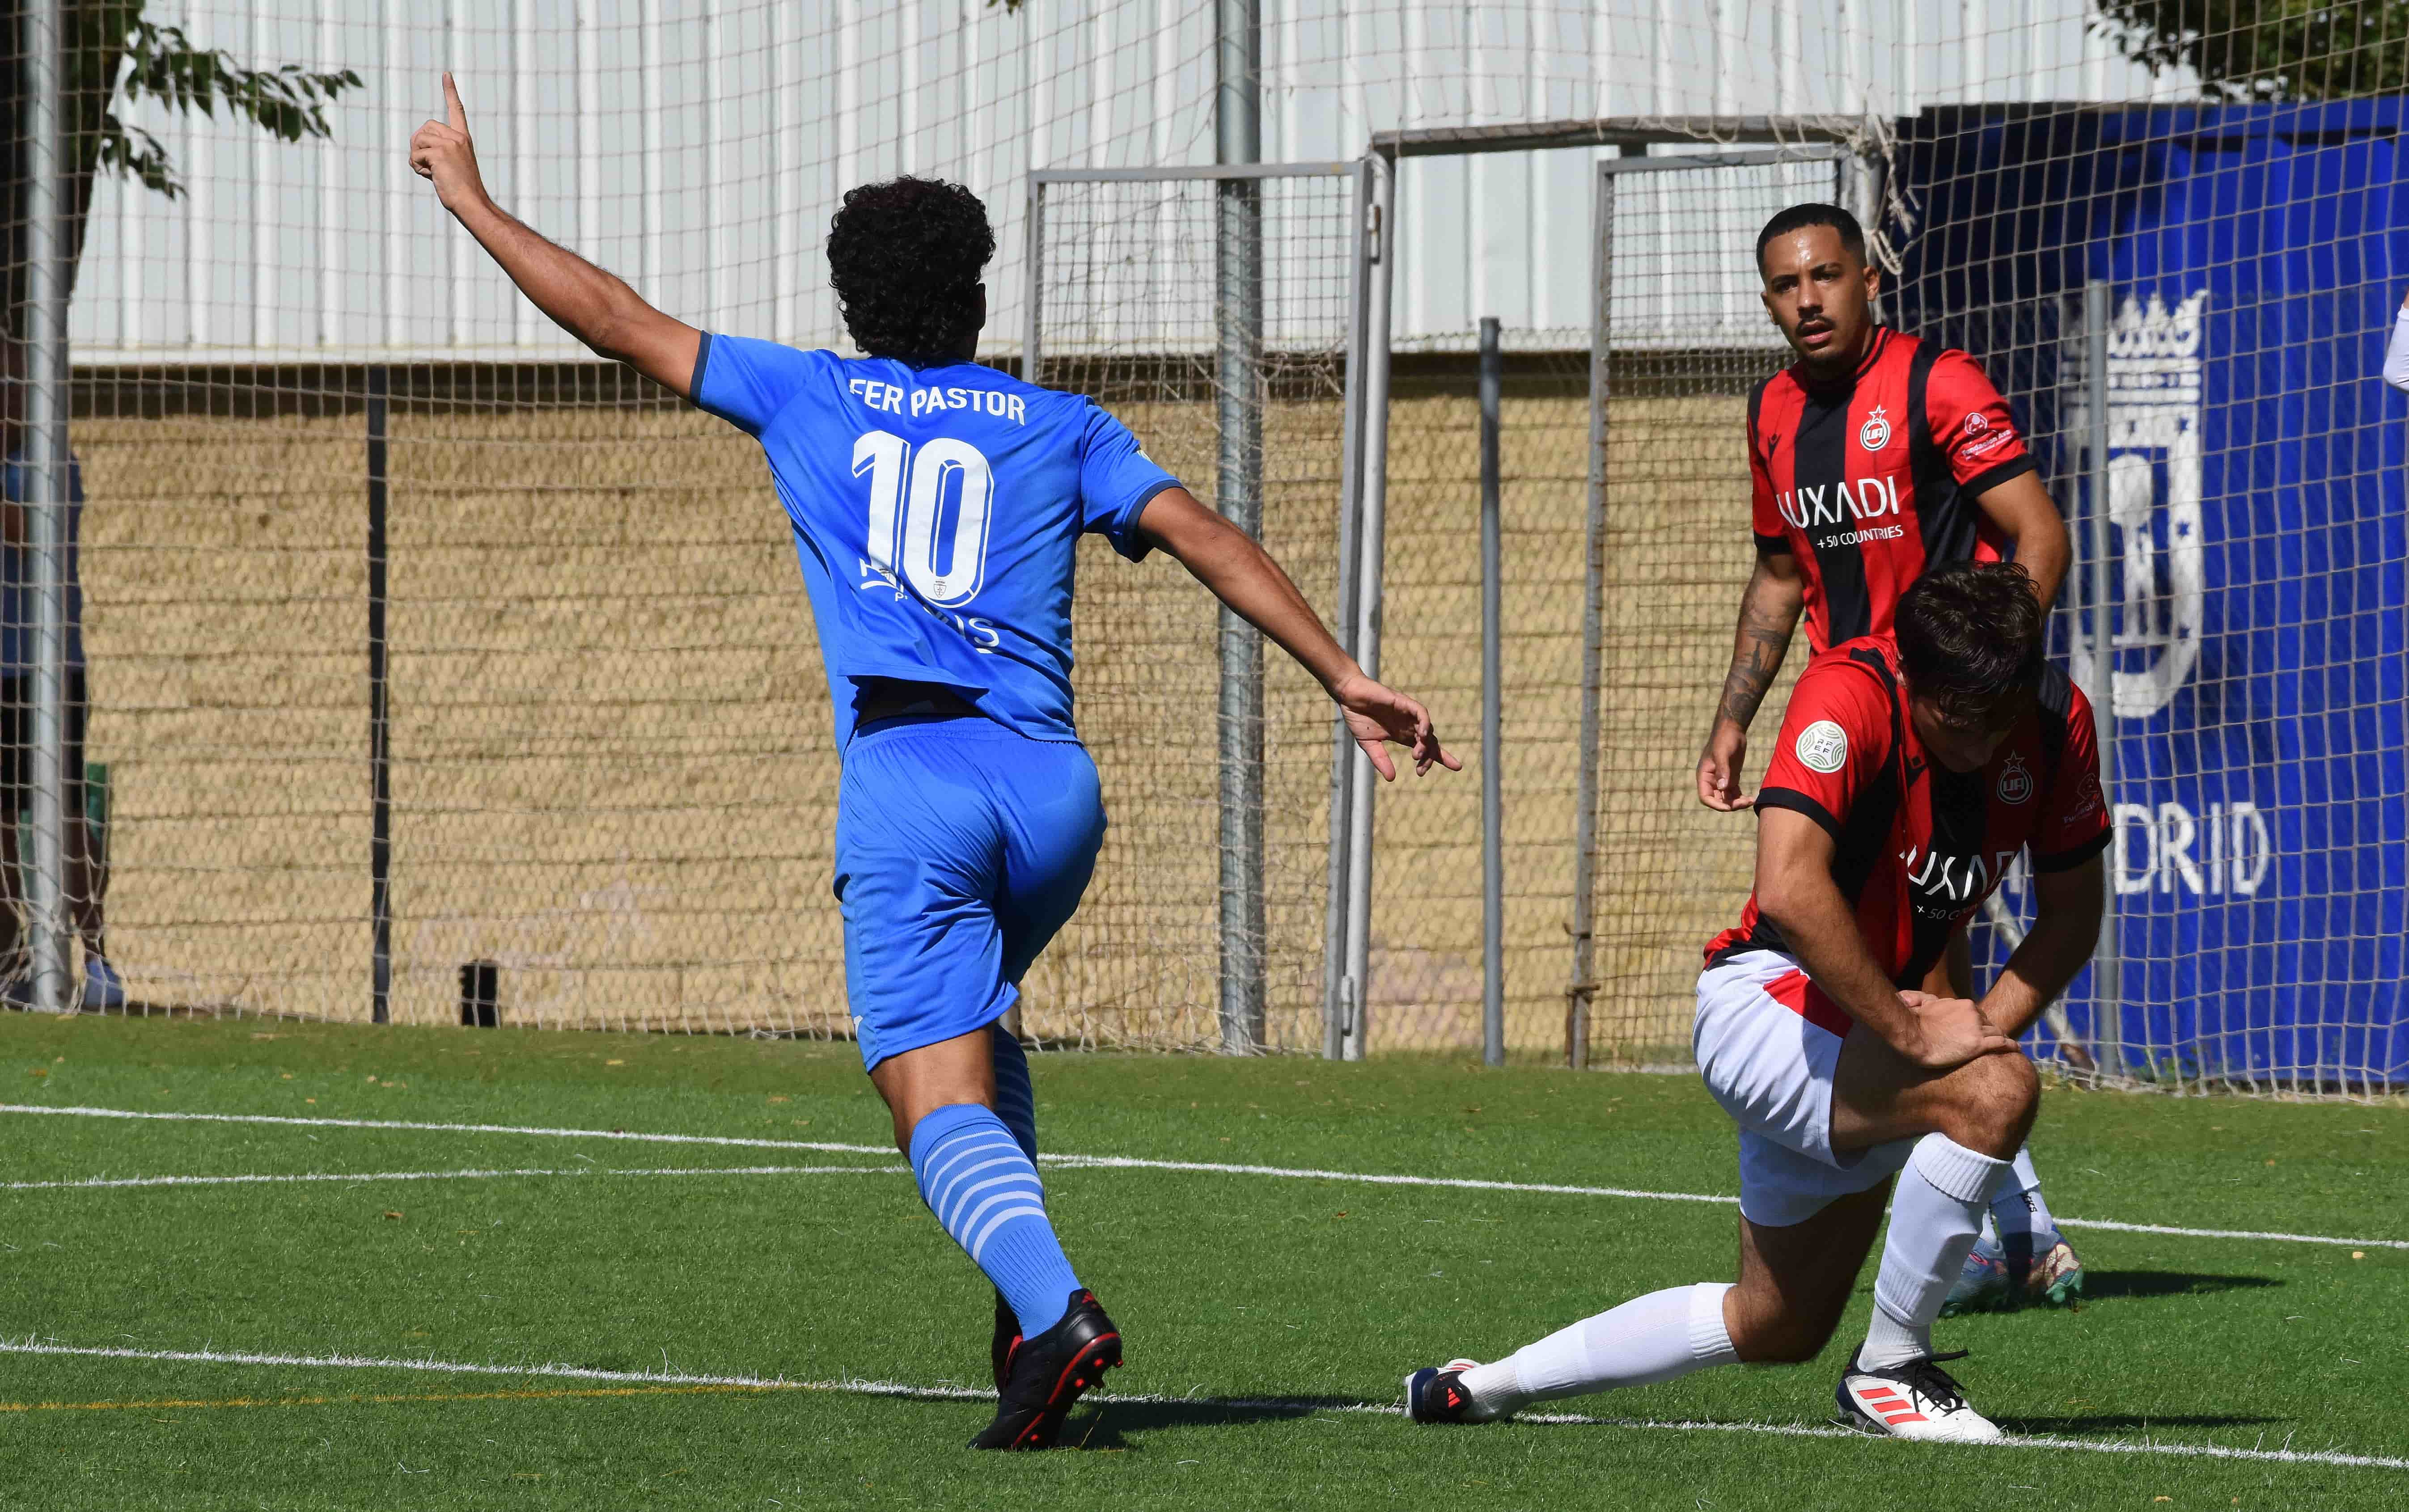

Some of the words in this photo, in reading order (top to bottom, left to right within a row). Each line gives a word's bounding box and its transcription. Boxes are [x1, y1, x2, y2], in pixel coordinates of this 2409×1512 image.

[850, 379, 904, 415] FER
[910, 386, 1025, 426] PASTOR
[852, 430, 995, 608] 10
[1827, 535, 1838, 548] 50
[1840, 524, 1904, 545] COUNTRIES
[2113, 802, 2270, 895] DRID
